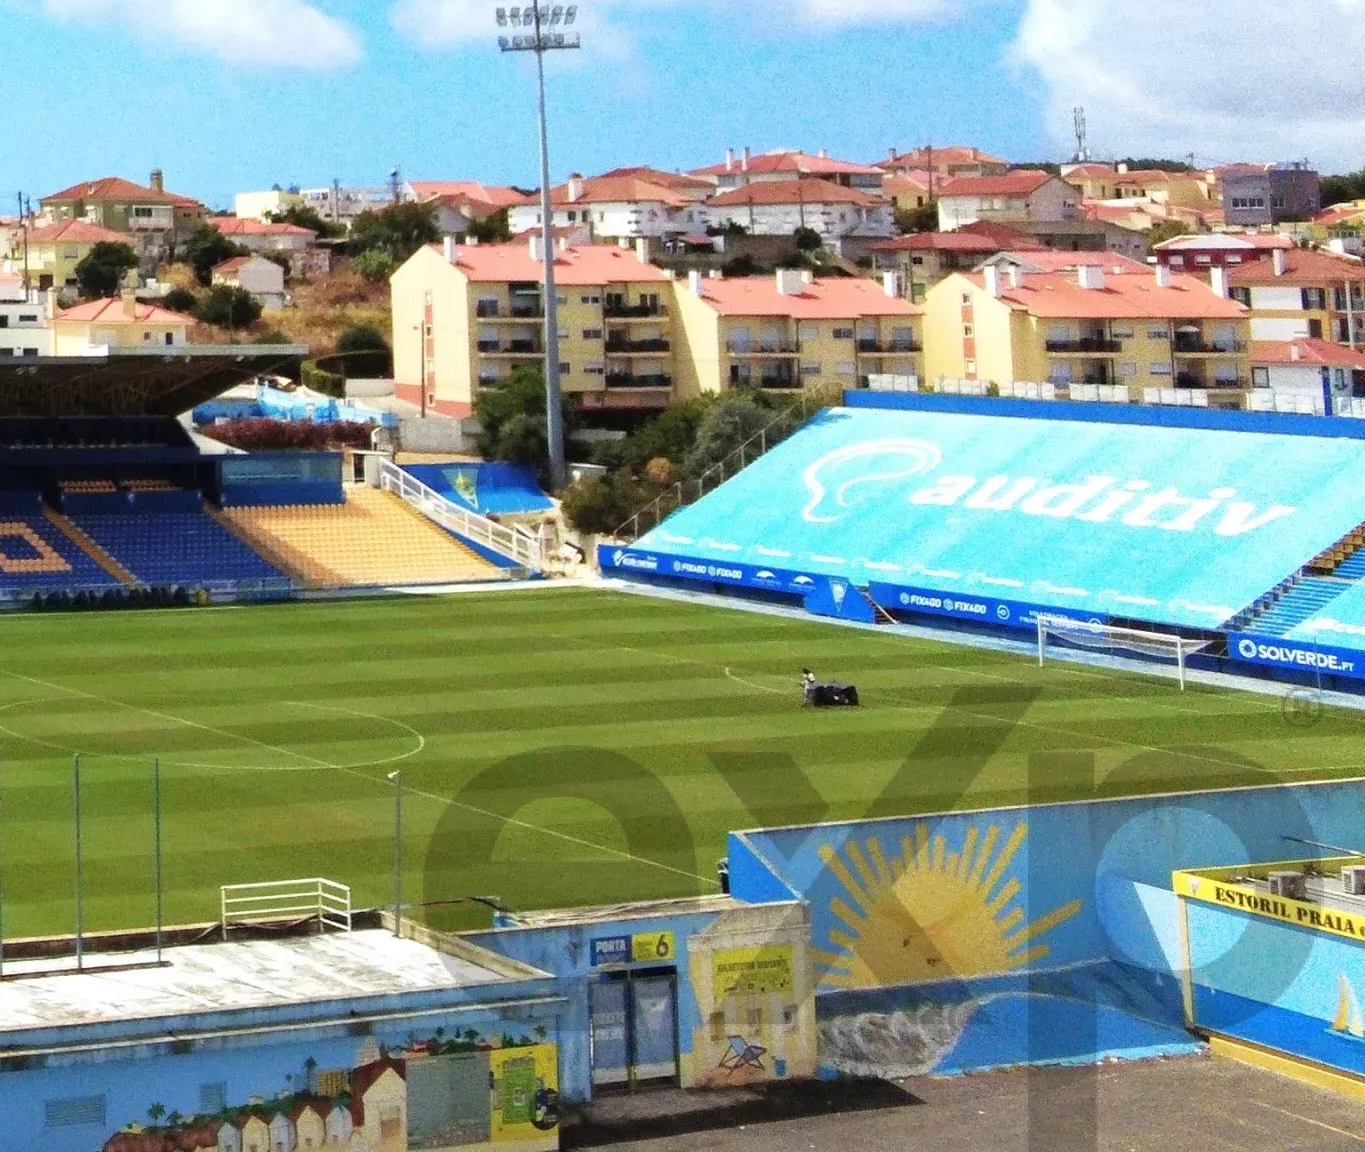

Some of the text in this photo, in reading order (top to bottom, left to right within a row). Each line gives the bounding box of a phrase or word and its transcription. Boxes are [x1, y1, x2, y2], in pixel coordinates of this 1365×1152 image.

[910, 474, 1297, 537] auditiv
[1258, 644, 1354, 673] SOLVERDE.PT
[1215, 886, 1356, 935] ESTORIL PRAIA
[596, 940, 627, 953] PORTA
[656, 934, 669, 958] 6
